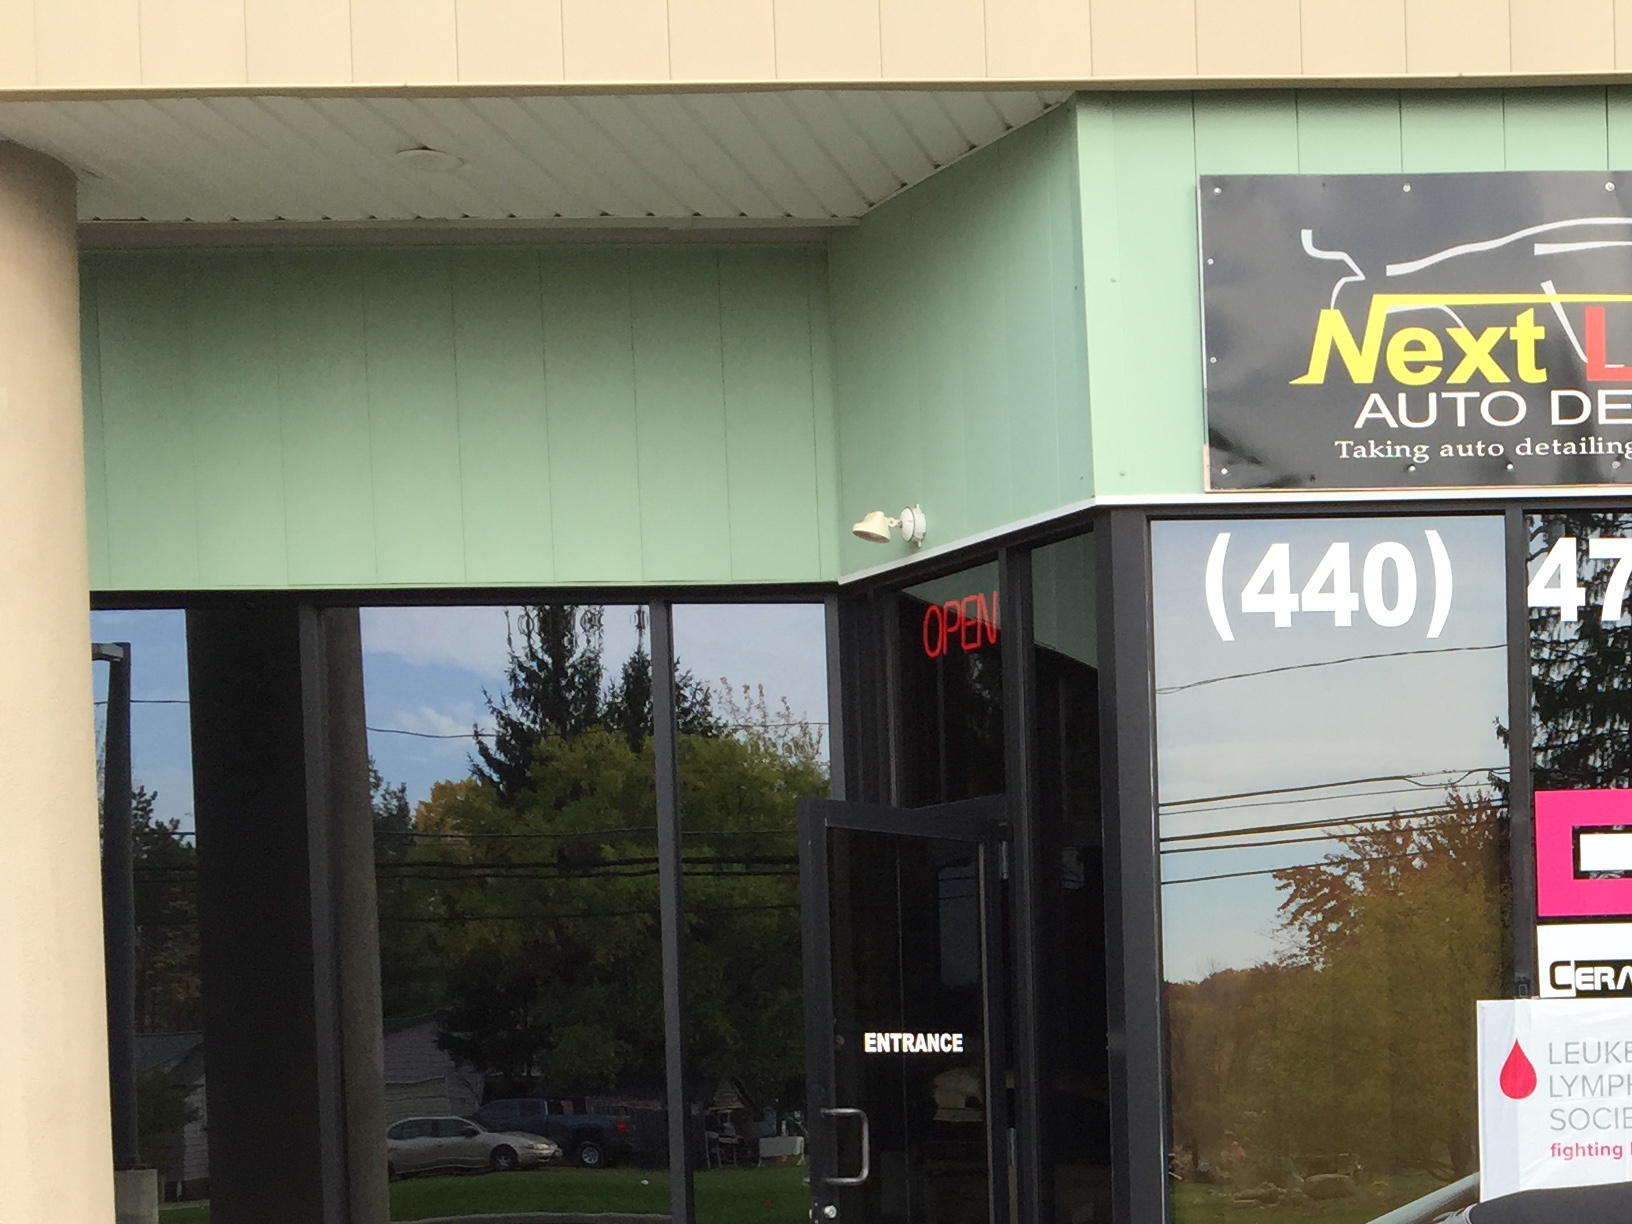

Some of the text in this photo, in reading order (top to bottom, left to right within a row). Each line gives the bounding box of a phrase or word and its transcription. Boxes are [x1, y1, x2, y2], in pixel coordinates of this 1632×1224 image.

[1290, 293, 1547, 385] Next
[1354, 390, 1527, 428] AUTO
[1334, 439, 1430, 463] Taking
[1439, 440, 1504, 457] auto
[1204, 529, 1454, 642] (440)
[923, 590, 998, 658] OPEN
[864, 1032, 964, 1053] ENTRANCE
[1550, 1142, 1624, 1160] fighting
